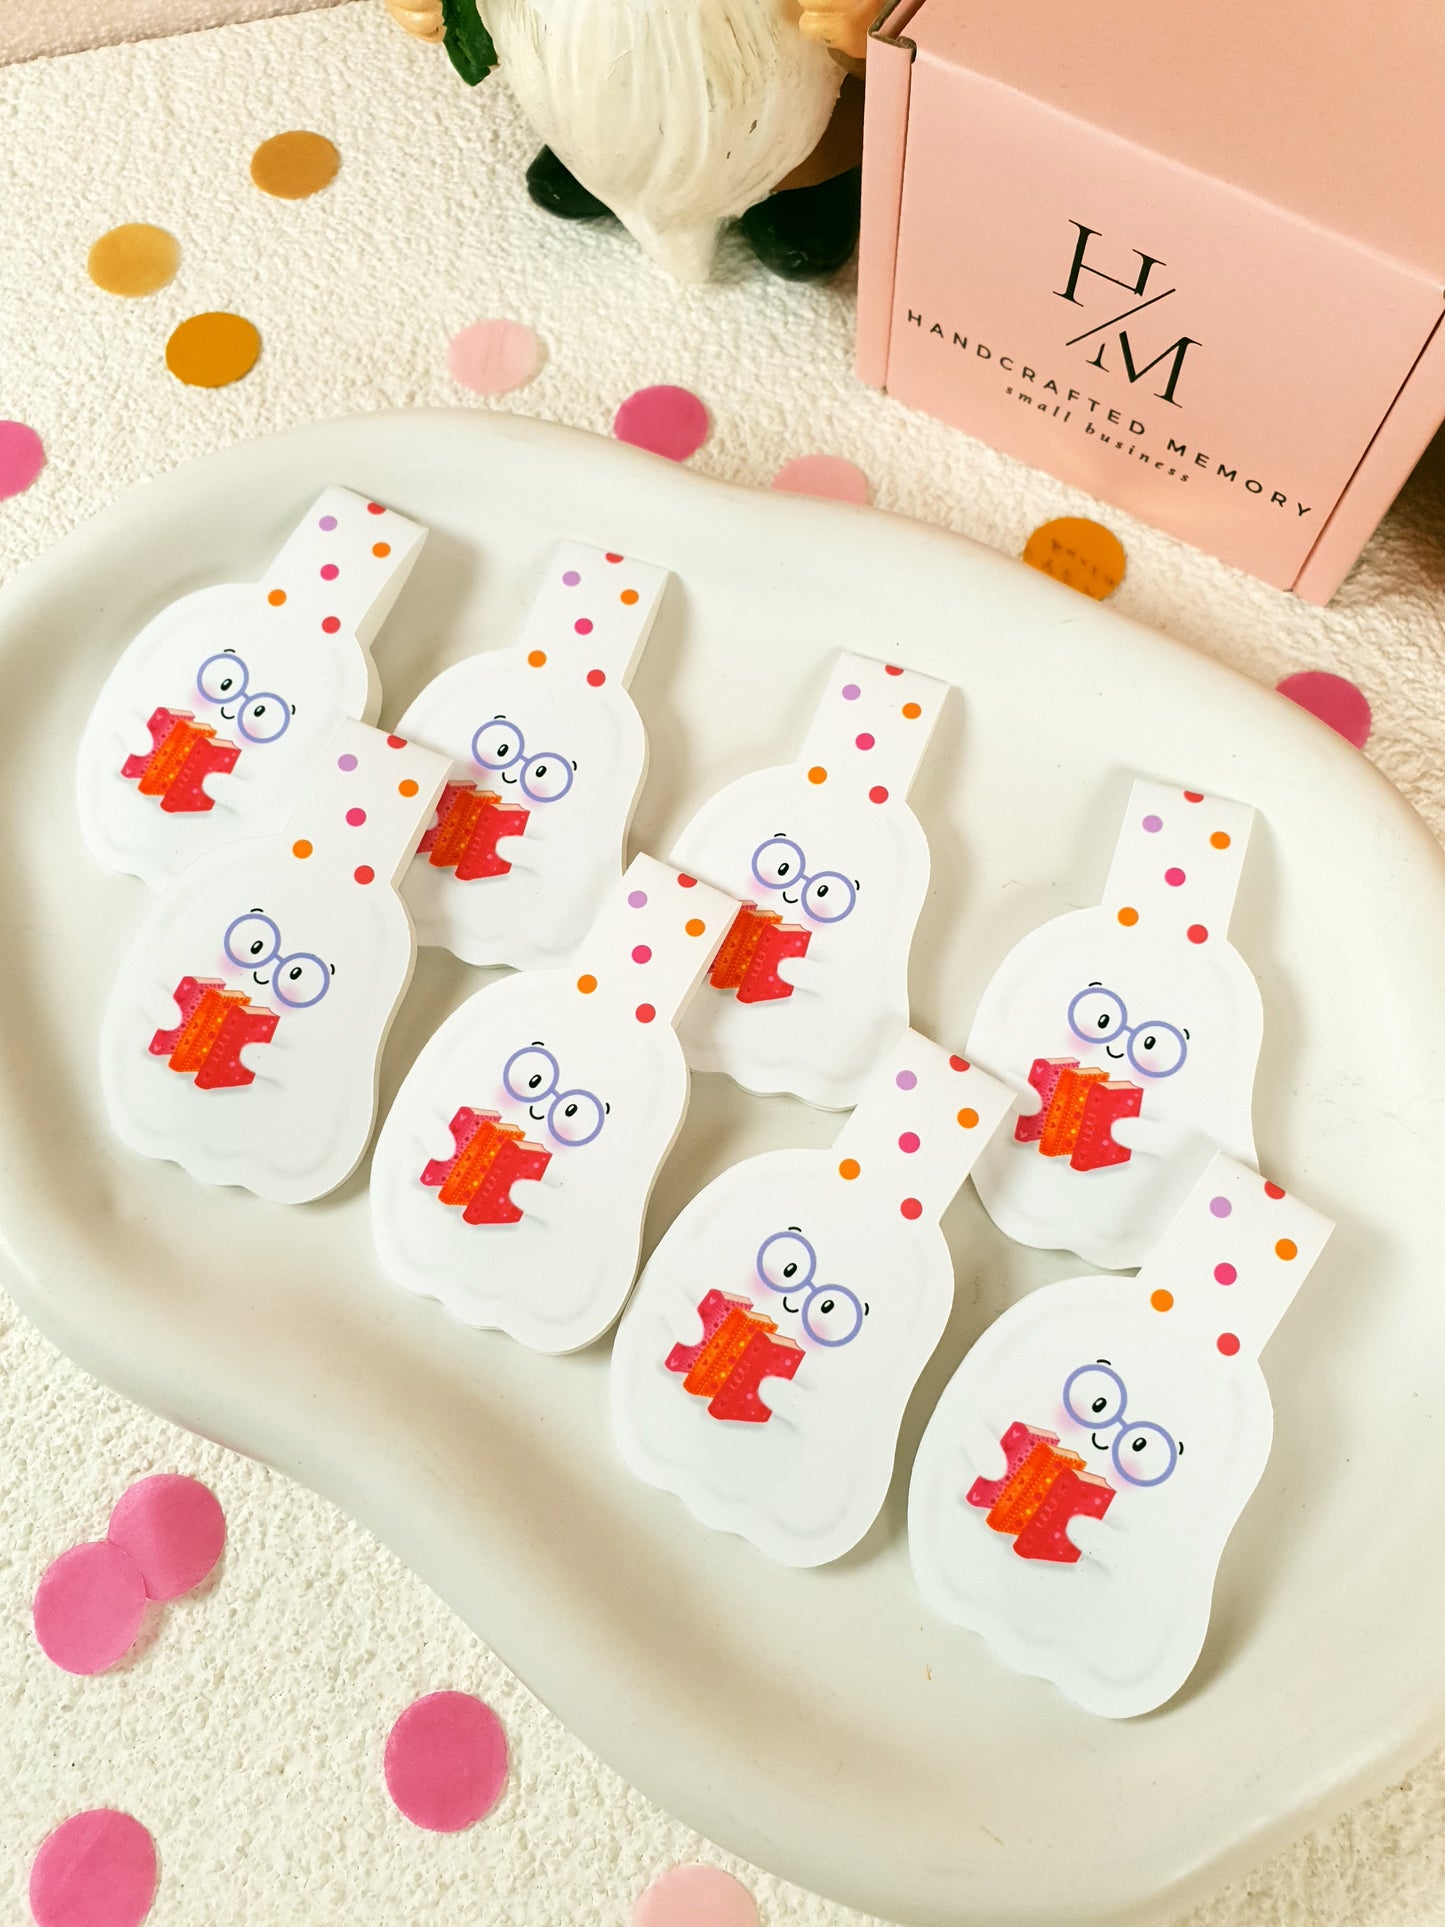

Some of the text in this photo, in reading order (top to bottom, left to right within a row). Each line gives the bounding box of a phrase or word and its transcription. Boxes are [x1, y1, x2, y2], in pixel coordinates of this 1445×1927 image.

[907, 308, 1312, 517] HANDCRAFTED MEMORY
[1005, 386, 1190, 483] small business
